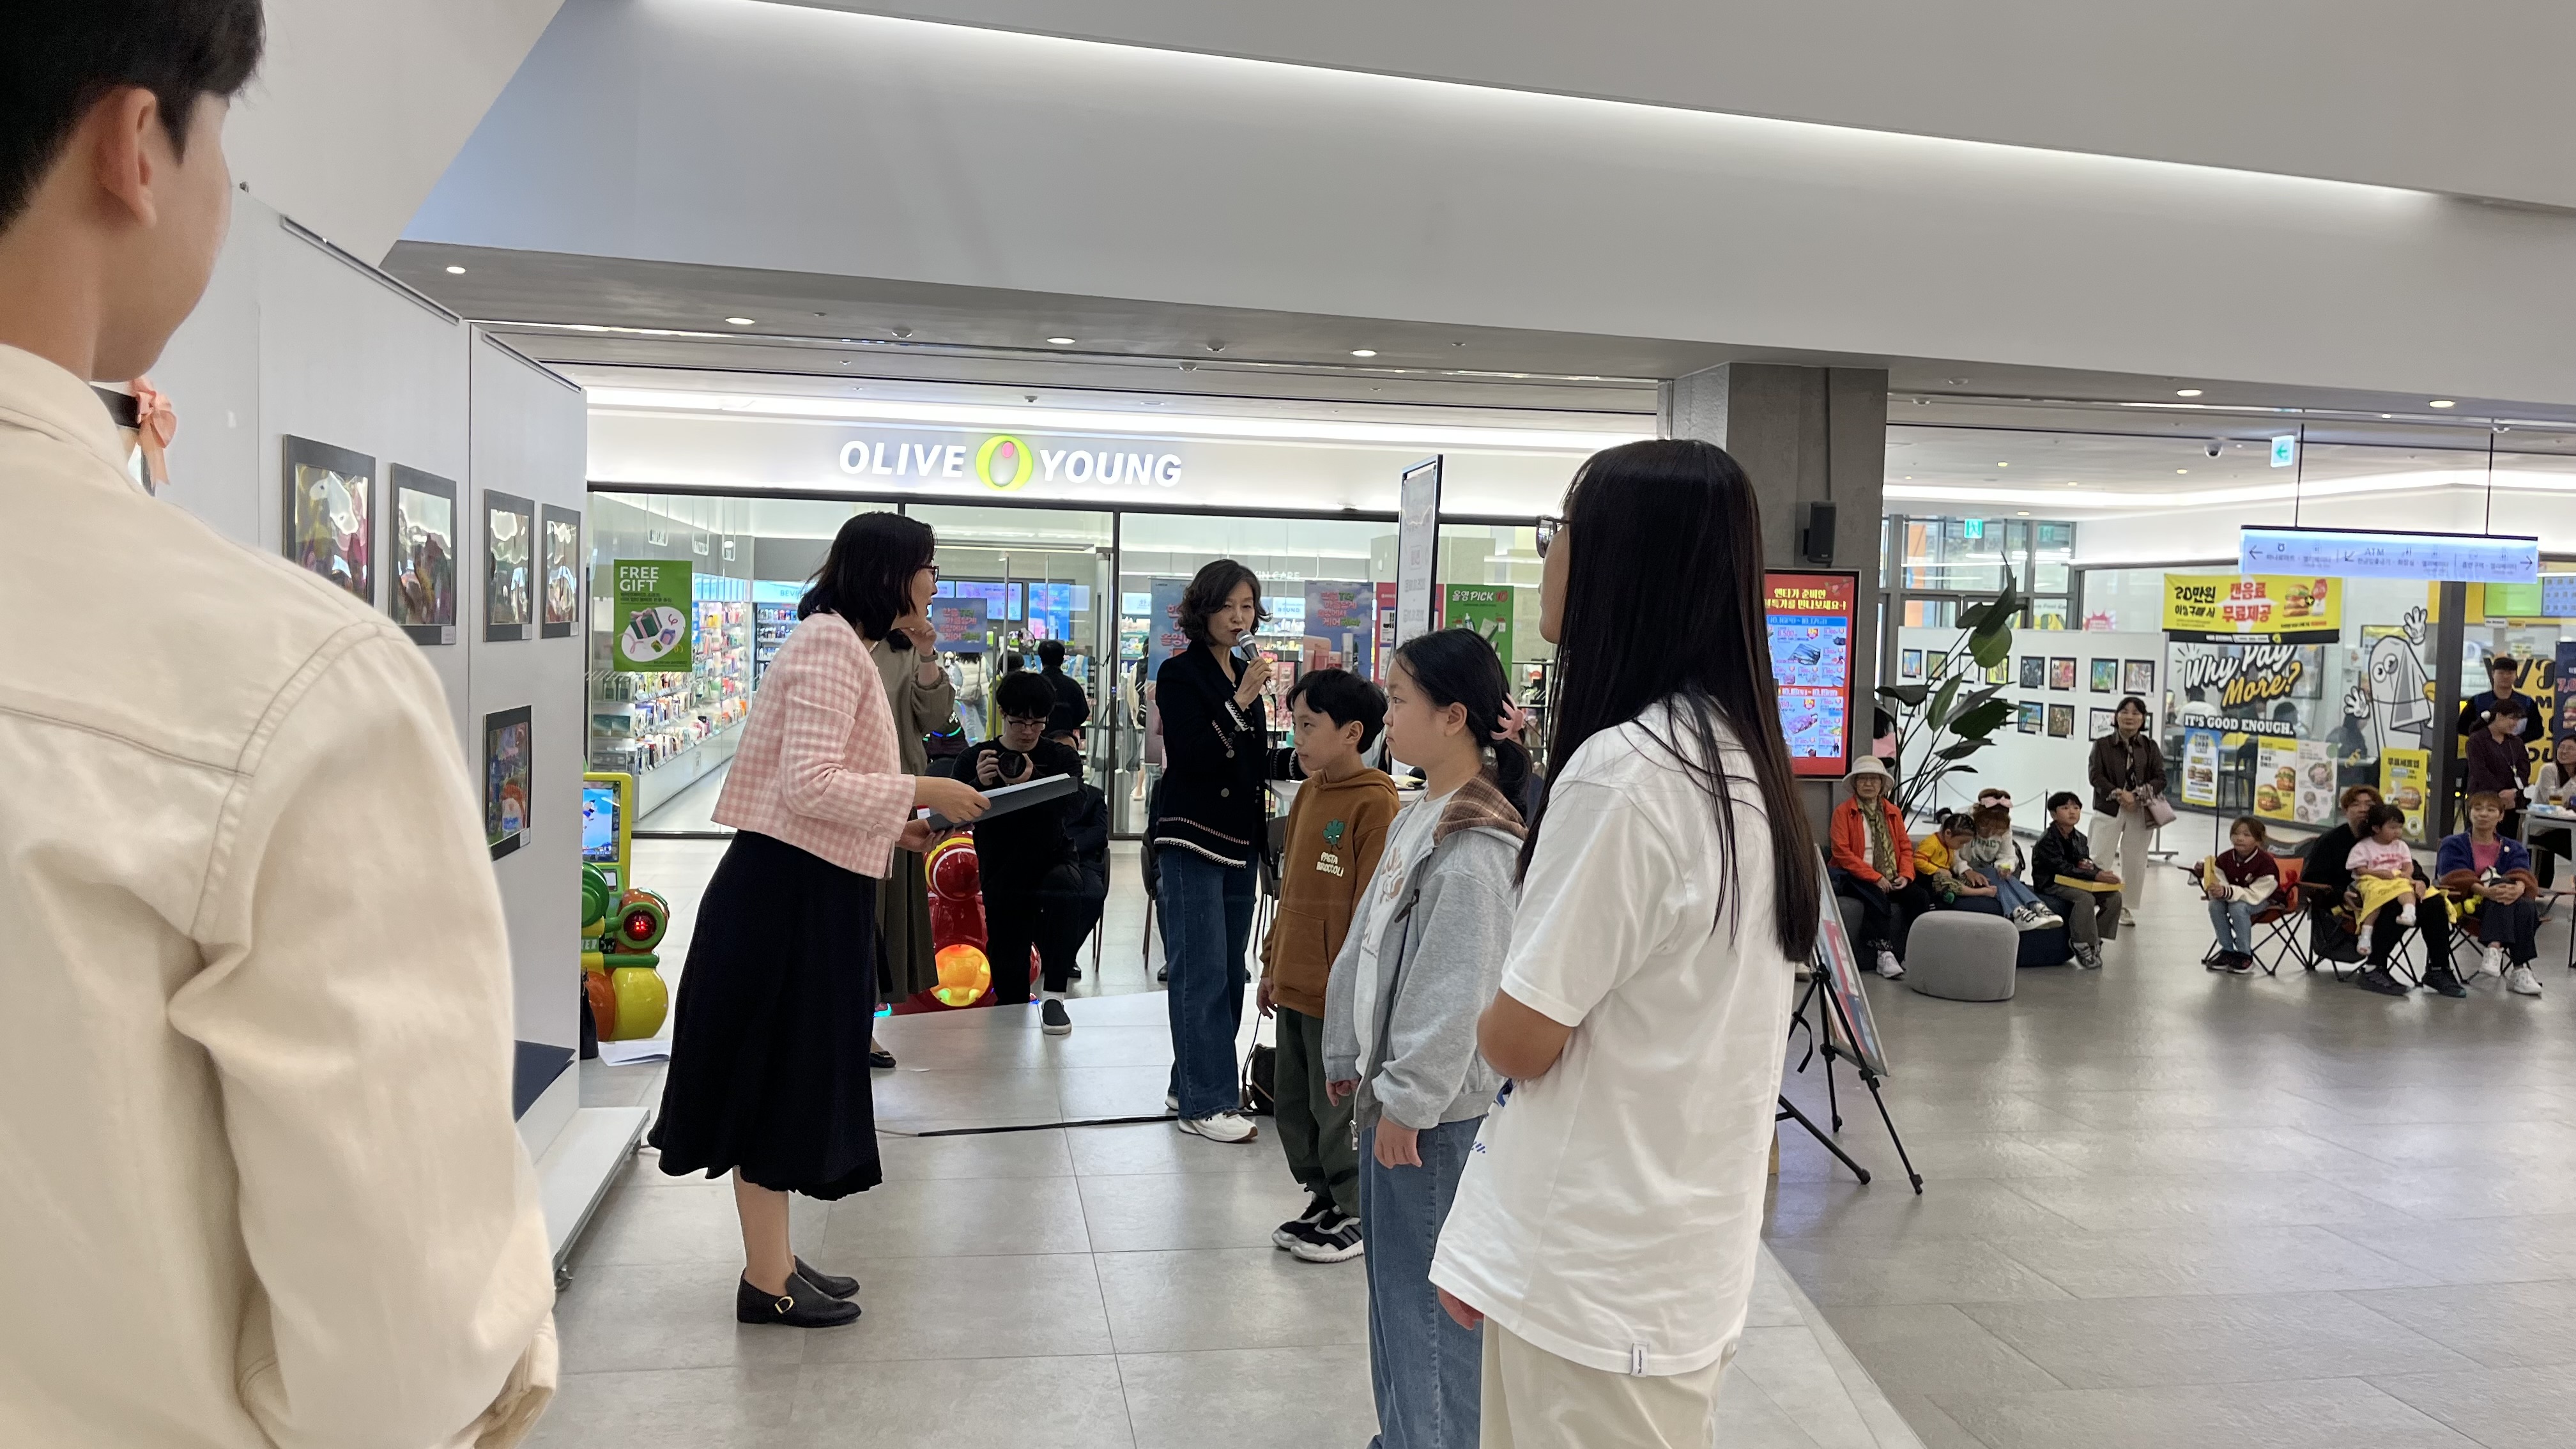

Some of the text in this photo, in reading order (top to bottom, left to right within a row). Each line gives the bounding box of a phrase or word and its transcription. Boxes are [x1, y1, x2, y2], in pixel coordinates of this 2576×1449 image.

[839, 440, 1183, 488] OLIVE YOUNG
[2365, 548, 2384, 556] ATM
[620, 566, 659, 579] FREE
[619, 579, 657, 592] GIFT
[2230, 582, 2266, 600] 캔음료
[2175, 586, 2216, 604] 20만원
[2222, 604, 2271, 623] 무료제공
[2185, 645, 2303, 707] Why Pay More?
[2184, 714, 2294, 735] IT'S GOOD ENOUGH.
[1321, 852, 1338, 864] PASTA
[1316, 861, 1344, 877] BROCCOLI
